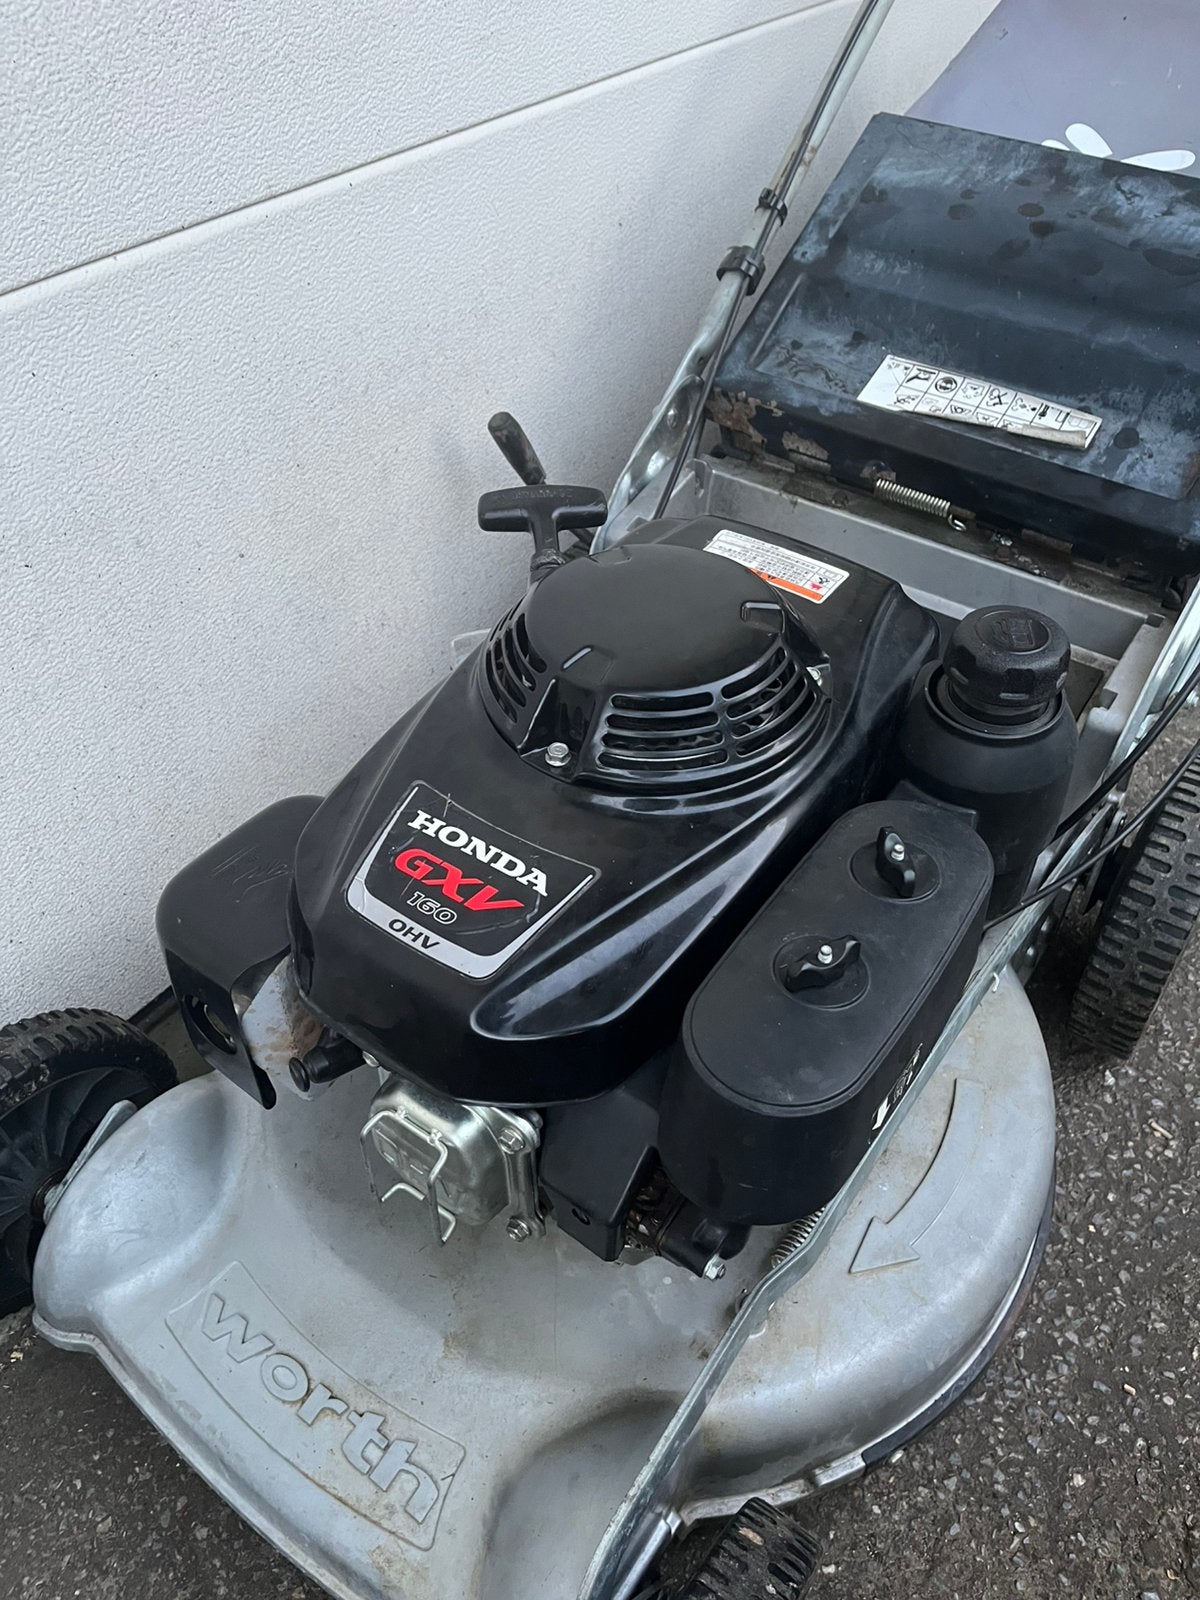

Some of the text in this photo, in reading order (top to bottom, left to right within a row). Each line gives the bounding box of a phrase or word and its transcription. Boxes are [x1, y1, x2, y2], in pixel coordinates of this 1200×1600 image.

[394, 848, 525, 911] GXV
[408, 810, 548, 896] HONDA
[388, 918, 440, 949] OHV
[407, 891, 457, 925] 160
[202, 1292, 440, 1525] worth
